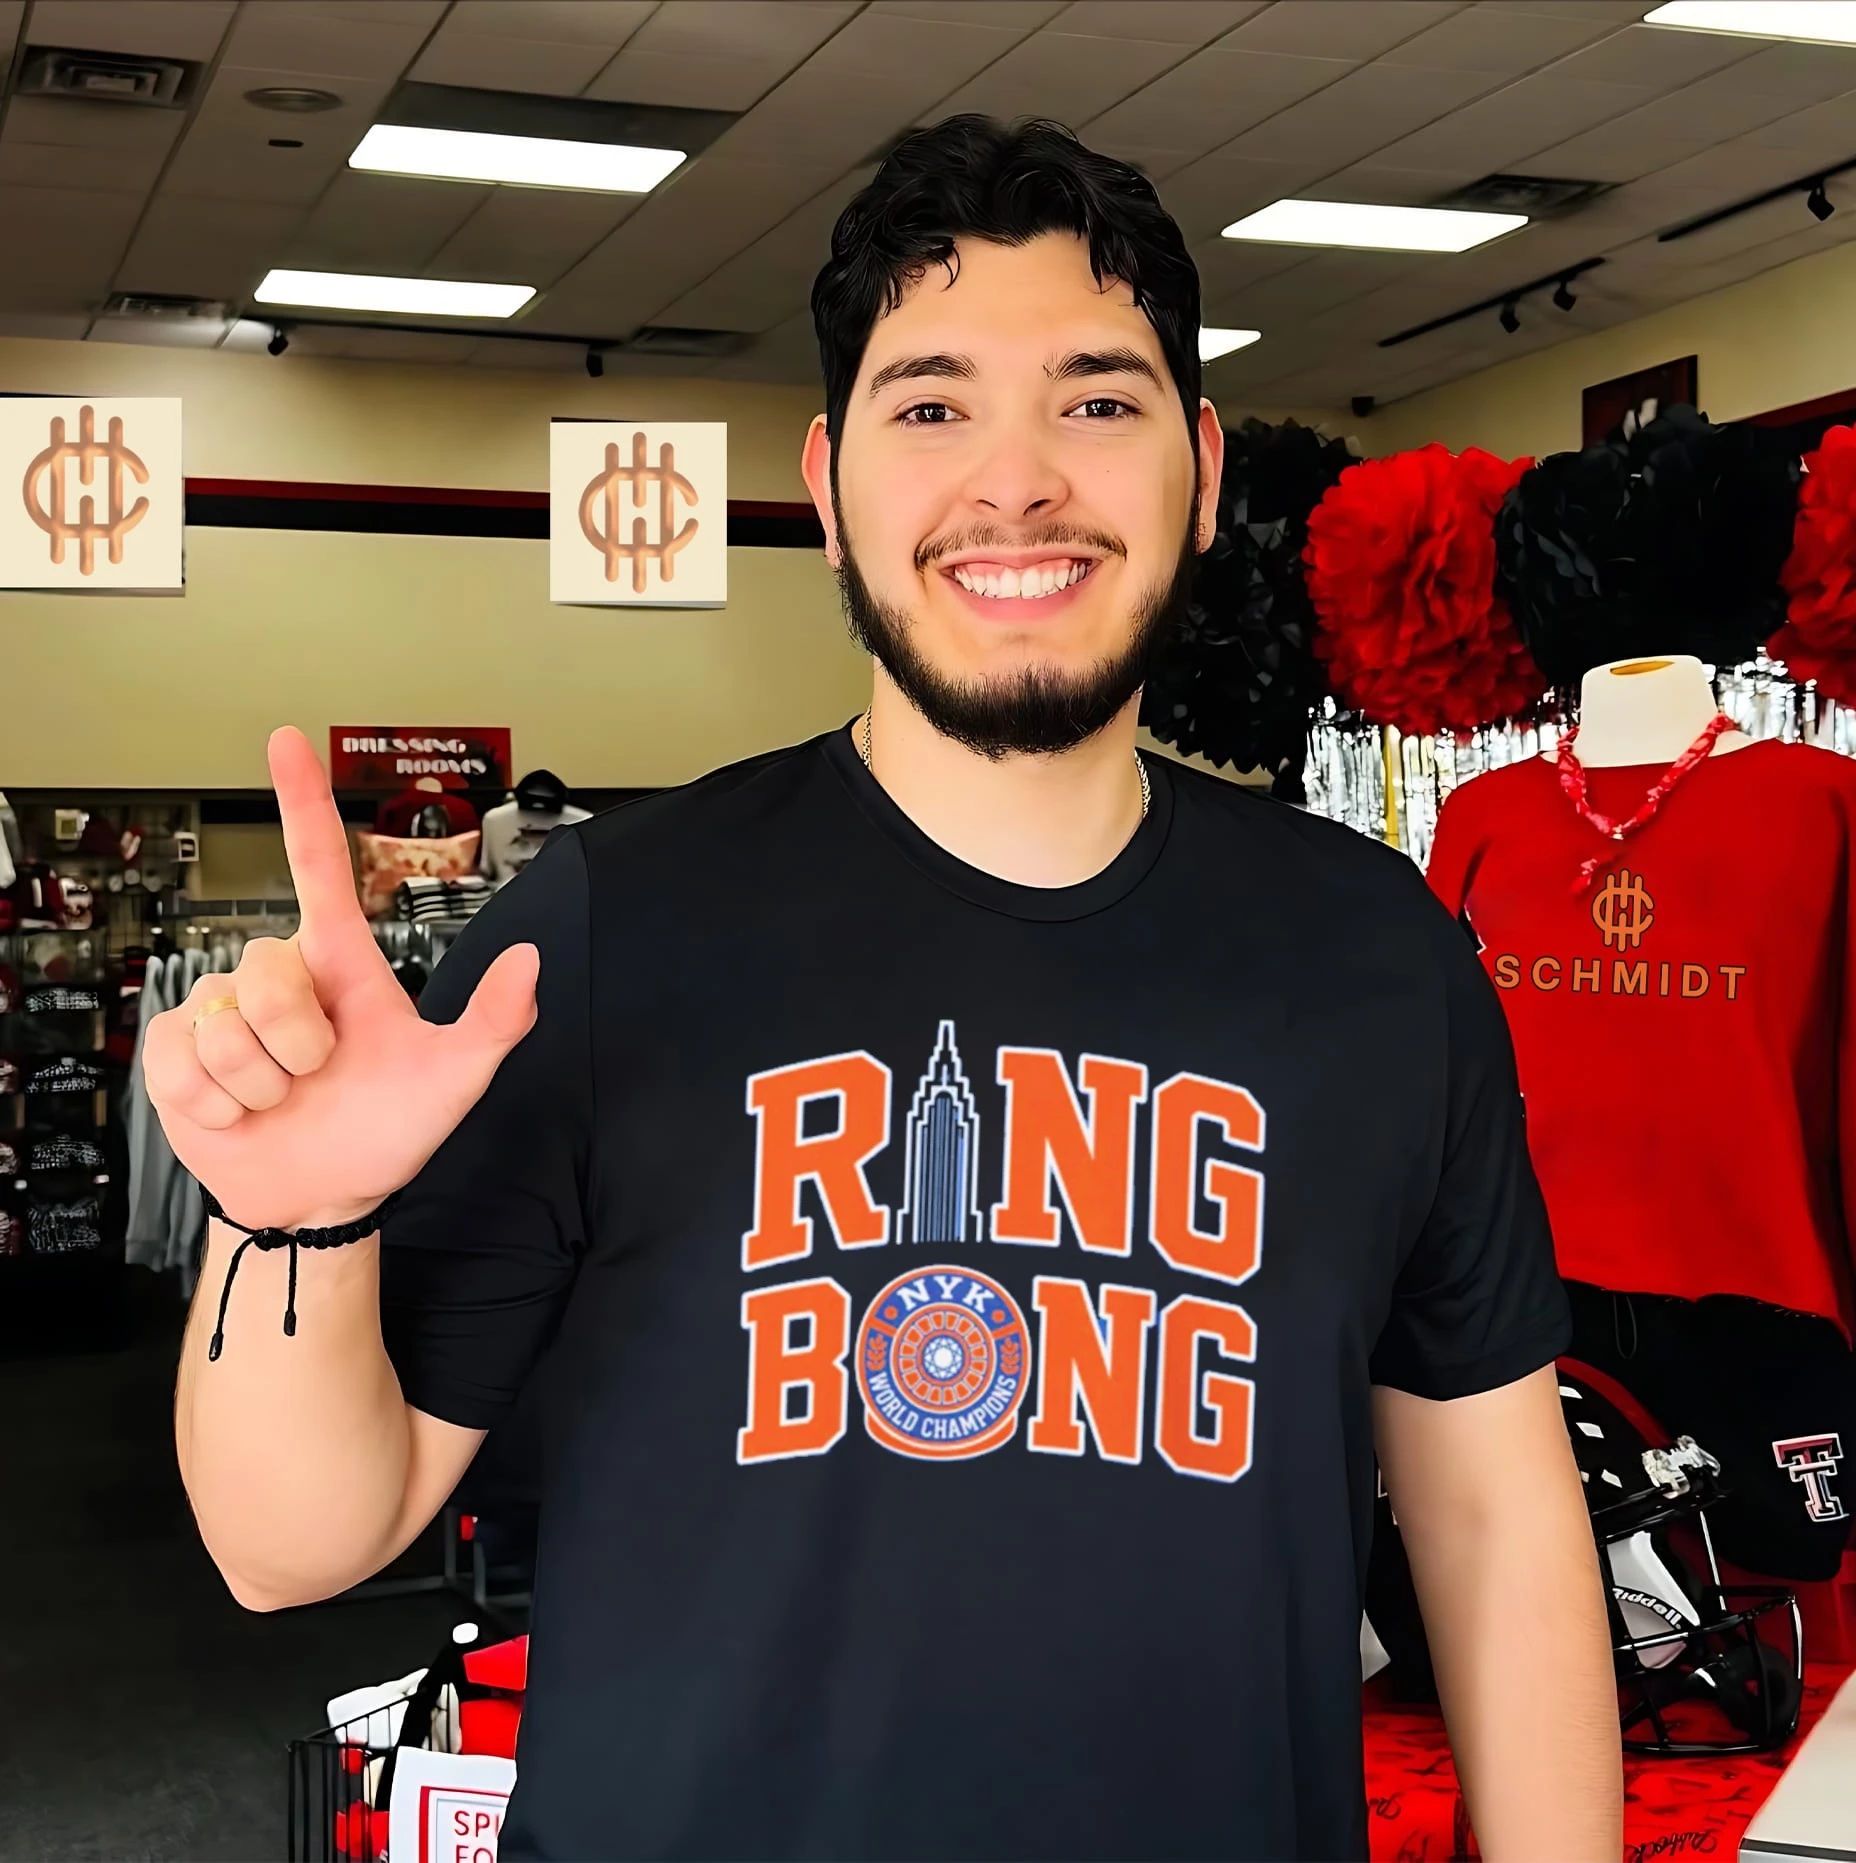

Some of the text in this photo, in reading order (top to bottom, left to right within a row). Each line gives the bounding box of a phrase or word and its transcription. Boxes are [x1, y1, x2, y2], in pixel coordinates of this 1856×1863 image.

[396, 758, 487, 775] ROOMS
[1494, 954, 1746, 1000] SCHMIDT
[897, 1275, 995, 1313] NYK
[869, 1372, 1017, 1439] WORLD CHAMPIONS
